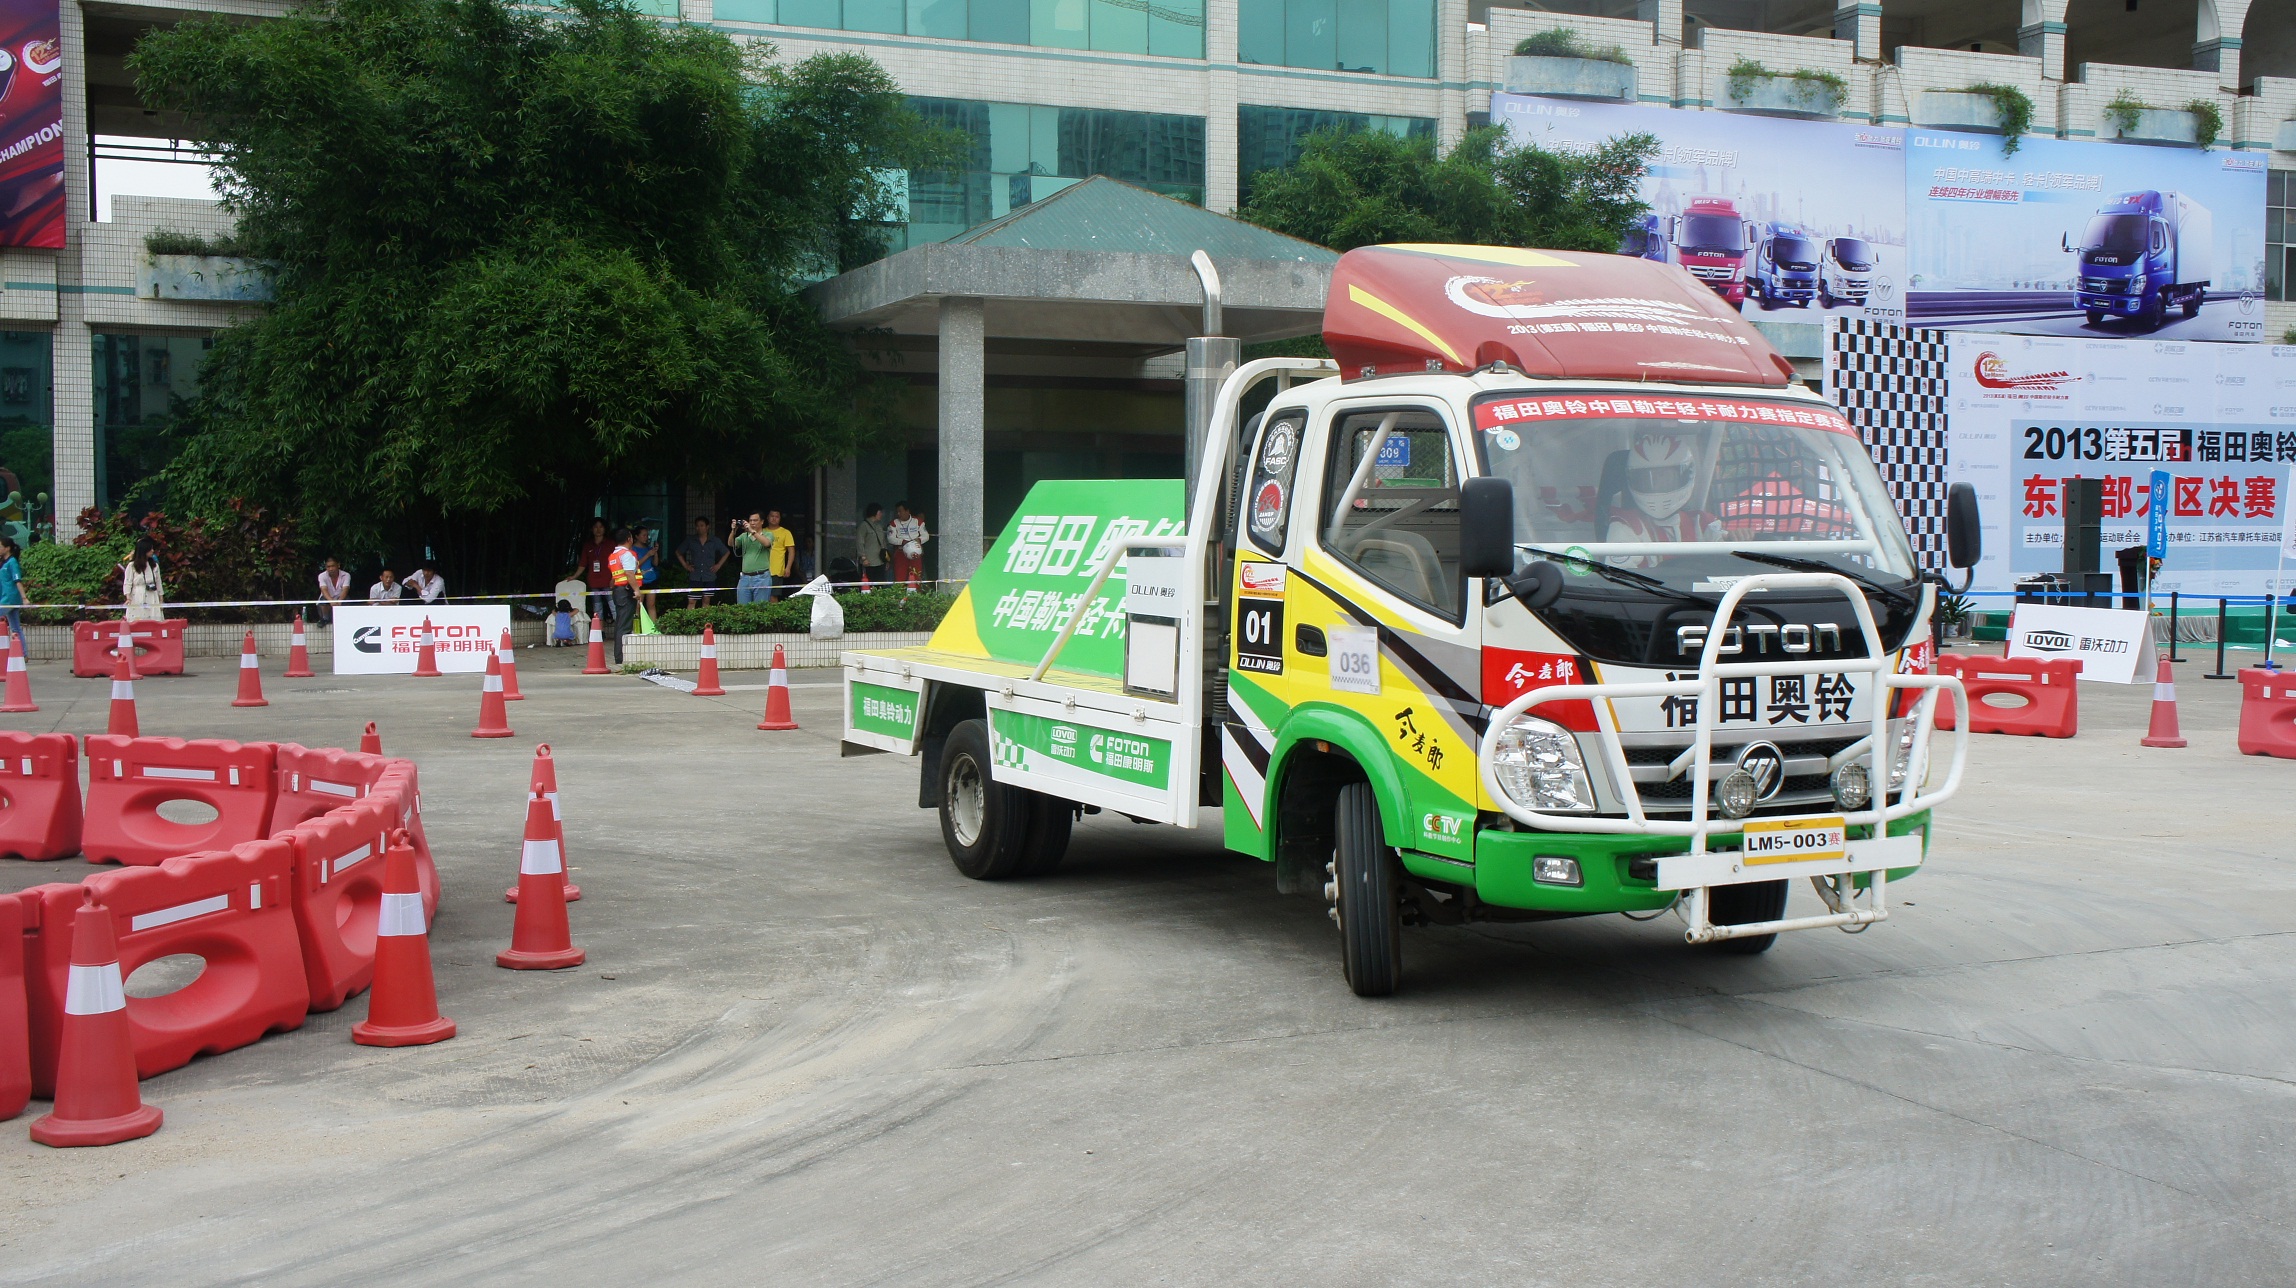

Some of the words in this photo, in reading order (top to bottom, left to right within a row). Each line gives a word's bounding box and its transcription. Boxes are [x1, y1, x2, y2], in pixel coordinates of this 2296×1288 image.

[1504, 102, 1552, 115] OLLIN
[1914, 136, 1955, 148] OLLIN
[1864, 307, 1903, 316] FOTON
[2228, 321, 2263, 330] FOTON
[1493, 399, 1848, 432] 福田奥铃中国勒芒轻卡耐力赛指定赛车
[1380, 447, 1399, 459] 309
[2197, 430, 2296, 463] 福田奥铃
[1265, 457, 1287, 465] FASC
[2165, 532, 2195, 543] 办单位：
[1131, 584, 1159, 596] OLLIN
[1160, 587, 1176, 598] 奥铃
[1245, 610, 1271, 645] 01
[1677, 622, 1841, 656] FOTON
[2026, 634, 2072, 648] LOVOL
[2079, 637, 2129, 654] 雷沃动力
[1240, 657, 1266, 669] OLLIN
[1340, 652, 1370, 675] 036
[1505, 659, 1574, 689] 今麦郎
[1661, 672, 1856, 727] 福田奥铃
[863, 696, 912, 725] 福田奥铃动力
[1052, 728, 1076, 740] LOVOL
[1395, 707, 1444, 771] 今麦郎
[1050, 743, 1076, 758] 雷沃动力
[1106, 736, 1149, 756] FOTON
[1106, 751, 1154, 774] 福田康明斯
[1423, 813, 1462, 835] CCTV
